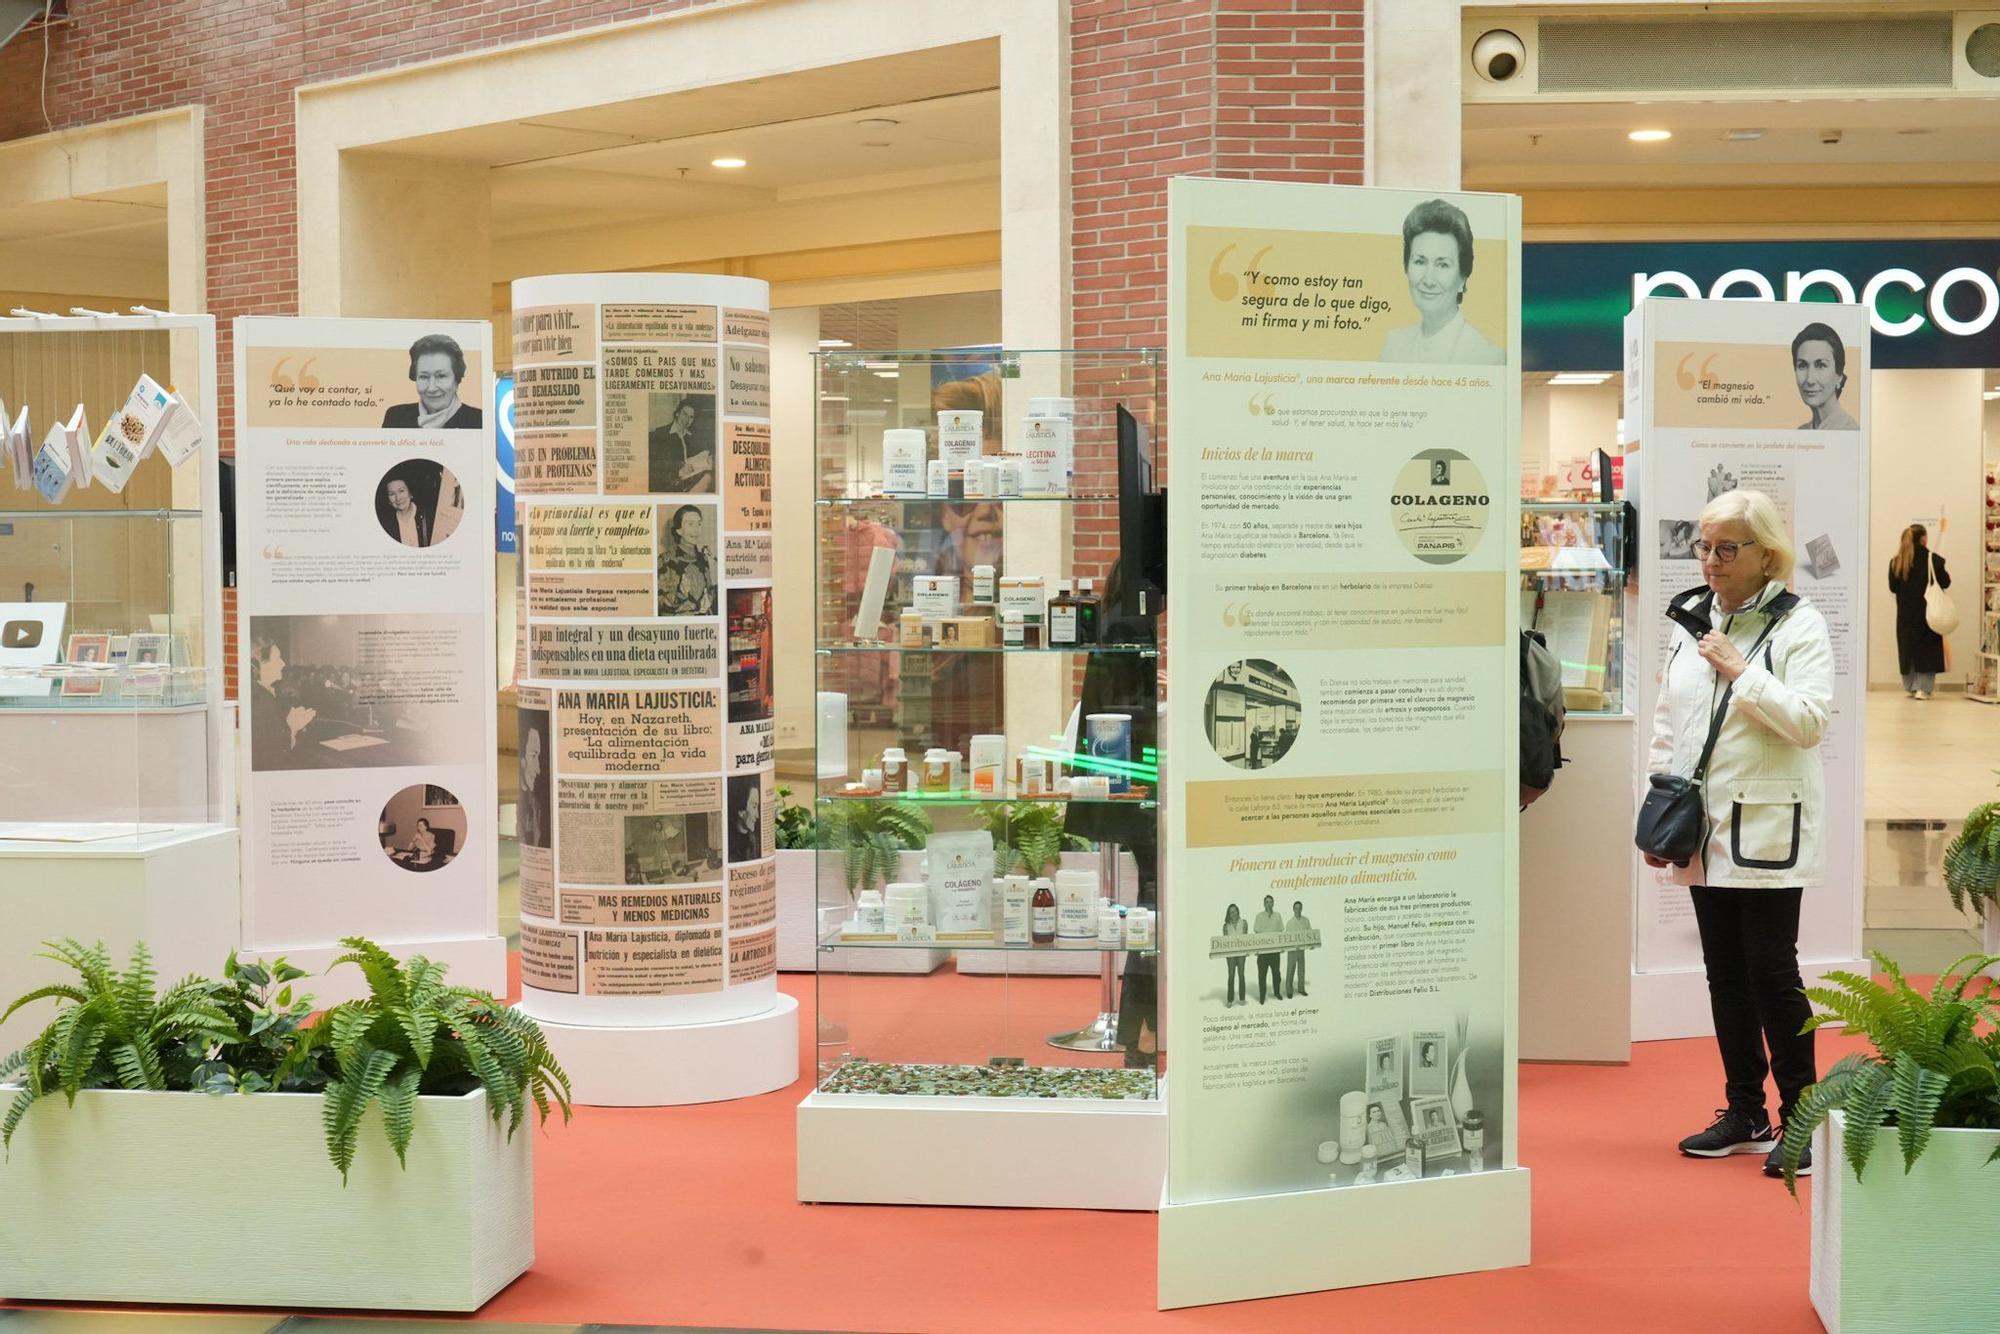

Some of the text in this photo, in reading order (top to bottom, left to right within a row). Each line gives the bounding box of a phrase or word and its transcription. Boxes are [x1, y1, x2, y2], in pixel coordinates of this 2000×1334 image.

[1264, 275, 1299, 286] como
[1304, 274, 1338, 291] estoy
[1342, 275, 1362, 288] tan
[1241, 292, 1391, 313] segura de lo que digo,
[1241, 314, 1257, 326] mi
[1262, 312, 1297, 328] firma
[1301, 318, 1310, 332] y
[1313, 316, 1329, 328] mi
[643, 357, 652, 366] EL
[658, 357, 676, 366] PAIS
[681, 357, 696, 366] QUE
[701, 358, 716, 368] MAS
[730, 356, 740, 372] No
[540, 367, 596, 381] NUTRIDO EL
[605, 368, 705, 379] TARDE COMEMOS Y MAS
[1202, 372, 1221, 382] Ana
[1306, 376, 1323, 385] una
[1326, 376, 1355, 385] marca
[1358, 374, 1399, 386] referente
[1403, 376, 1429, 387] desde
[1431, 376, 1453, 388] hace
[1455, 377, 1466, 387] 45
[299, 386, 315, 395] voy
[328, 385, 360, 396] contar,
[364, 385, 373, 394] si
[532, 383, 580, 397] DEMASIADO
[605, 380, 655, 390] LIGERAMENTE
[1713, 381, 1754, 393] magnesio
[268, 398, 281, 408] ya
[284, 397, 293, 406] lo
[296, 397, 308, 406] he
[311, 397, 351, 407] contado
[1697, 393, 1728, 404] cambió
[1731, 395, 1742, 404] mi
[551, 446, 596, 461] PROBLEMA
[1201, 447, 1313, 462] Inicios de la marca
[1201, 493, 1238, 502] personales,
[1390, 494, 1490, 506] COLAGENO
[543, 506, 651, 522] primordial es que el
[569, 524, 594, 537] fuerte
[595, 527, 602, 540] y
[1417, 542, 1456, 550] PANAPIS
[1225, 584, 1246, 593] primer
[1248, 582, 1270, 592] trabajo
[1281, 582, 1312, 591] Barcelona
[555, 626, 593, 644] integral
[598, 630, 603, 645] y
[609, 629, 623, 642] un
[628, 626, 680, 645] desayuno
[591, 649, 603, 661] en
[606, 649, 626, 661] una
[628, 646, 655, 661] dieta
[658, 645, 717, 664] equilibrada
[558, 692, 581, 709] ANA
[586, 692, 630, 709] MARIA
[636, 690, 716, 709] LAJUSTICIA:
[563, 725, 637, 738] presentación
[643, 725, 658, 736] de
[664, 728, 677, 736] su
[607, 736, 689, 748] alimentación
[568, 747, 706, 761] equilibrada en la vida
[1230, 849, 1457, 872] Pionera en introducir el magnesio como
[1270, 868, 1417, 891] complemento alimenticio.
[598, 892, 721, 908] MAS REMEDIOS NATURALES
[612, 908, 709, 922] Y MENOS MEDICINAS
[589, 931, 602, 942] Ana
[631, 931, 671, 945] Lajusticia,
[675, 929, 711, 943] diplomada
[714, 929, 721, 938] en
[1212, 936, 1274, 949] Distribuciones
[624, 951, 628, 962] y
[632, 948, 677, 962] especialista
[681, 949, 689, 959] en
